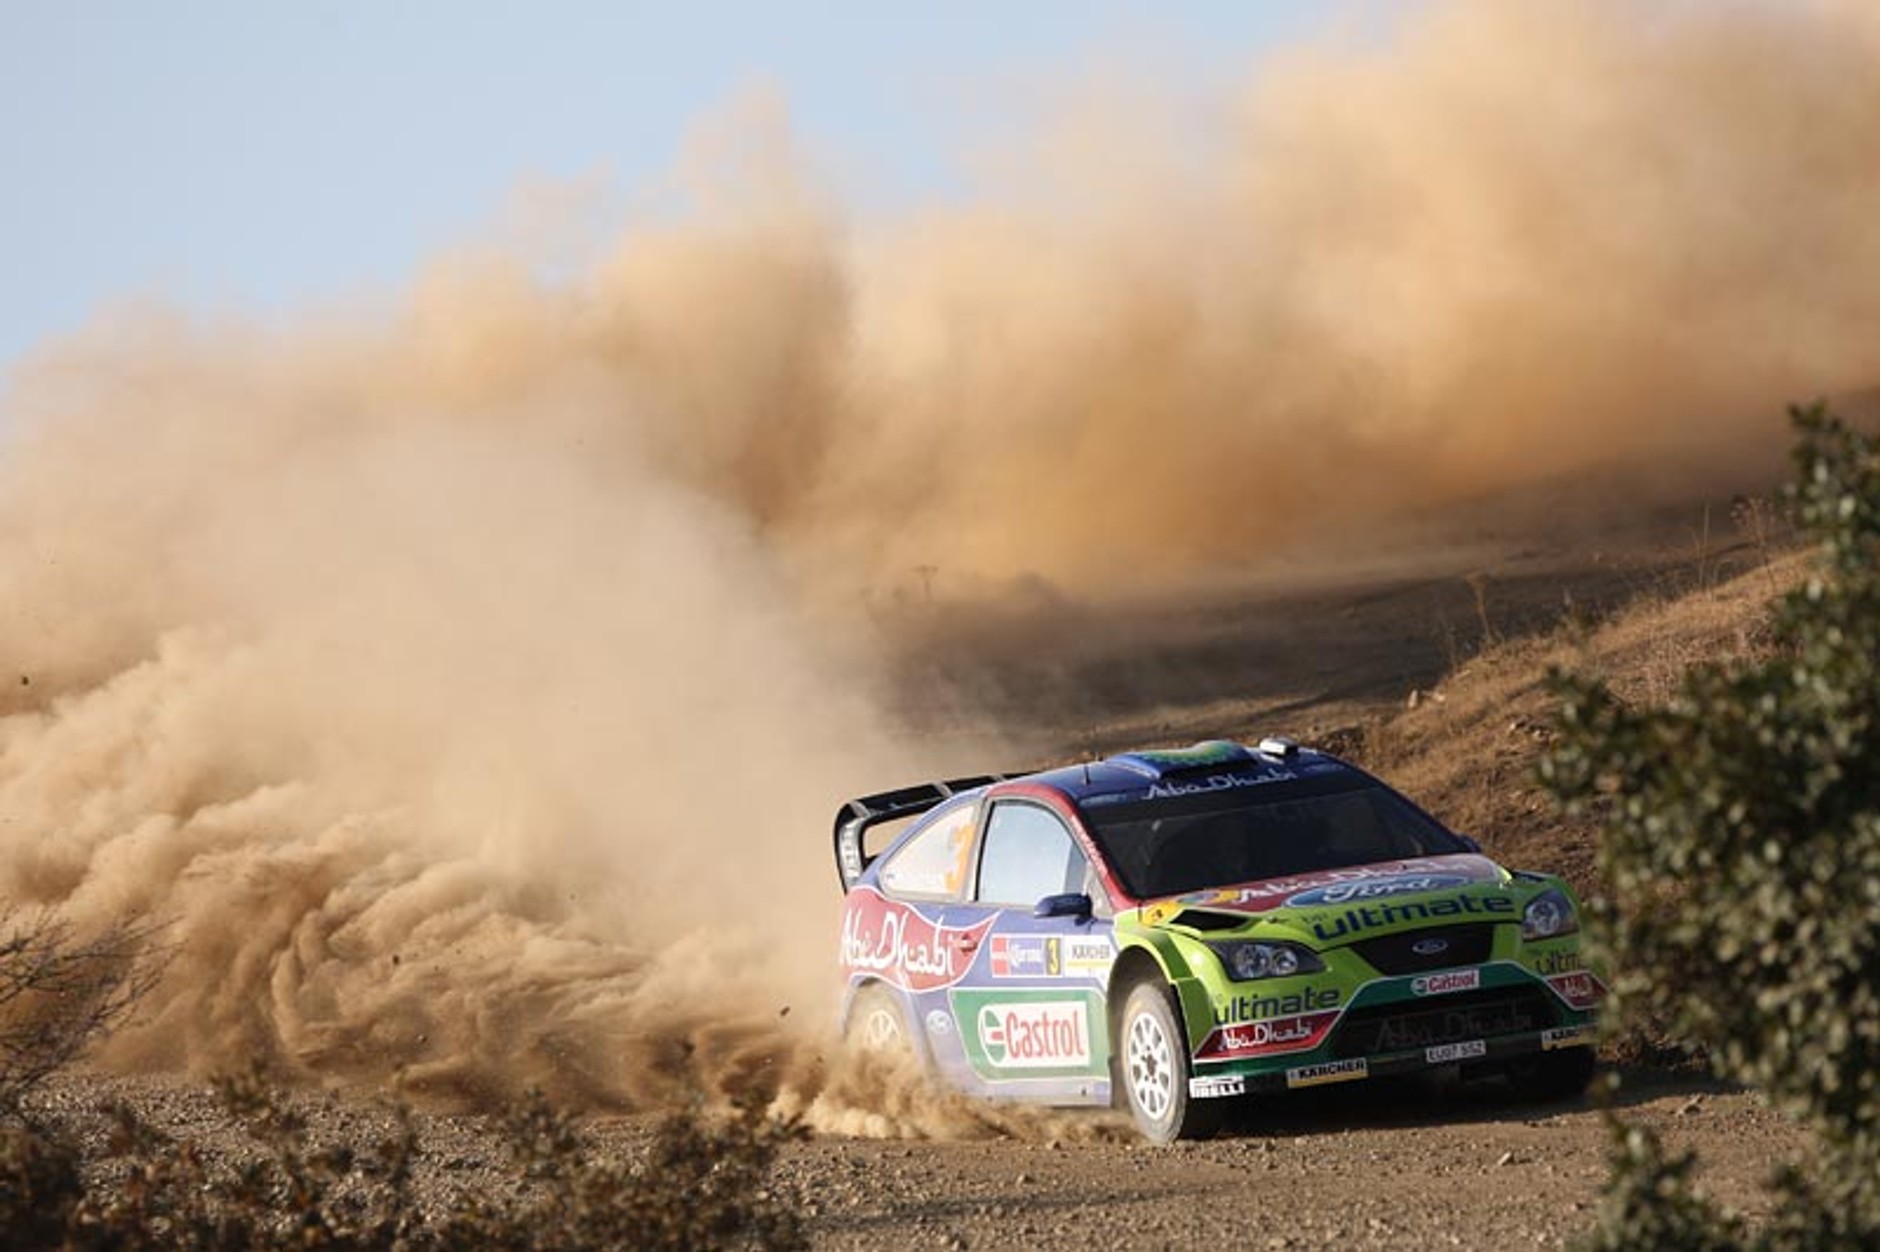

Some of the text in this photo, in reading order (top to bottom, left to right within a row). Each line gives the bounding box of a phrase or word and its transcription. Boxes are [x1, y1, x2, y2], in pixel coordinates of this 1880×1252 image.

[1323, 877, 1432, 902] Ford
[1313, 893, 1516, 942] ultimate
[871, 910, 956, 984] Dhabi
[1046, 938, 1060, 976] 3
[1428, 971, 1475, 993] Castrol
[1213, 985, 1340, 1026] ultimate
[1005, 1009, 1086, 1059] Castrol
[1217, 1018, 1314, 1051] Abu Dhabi
